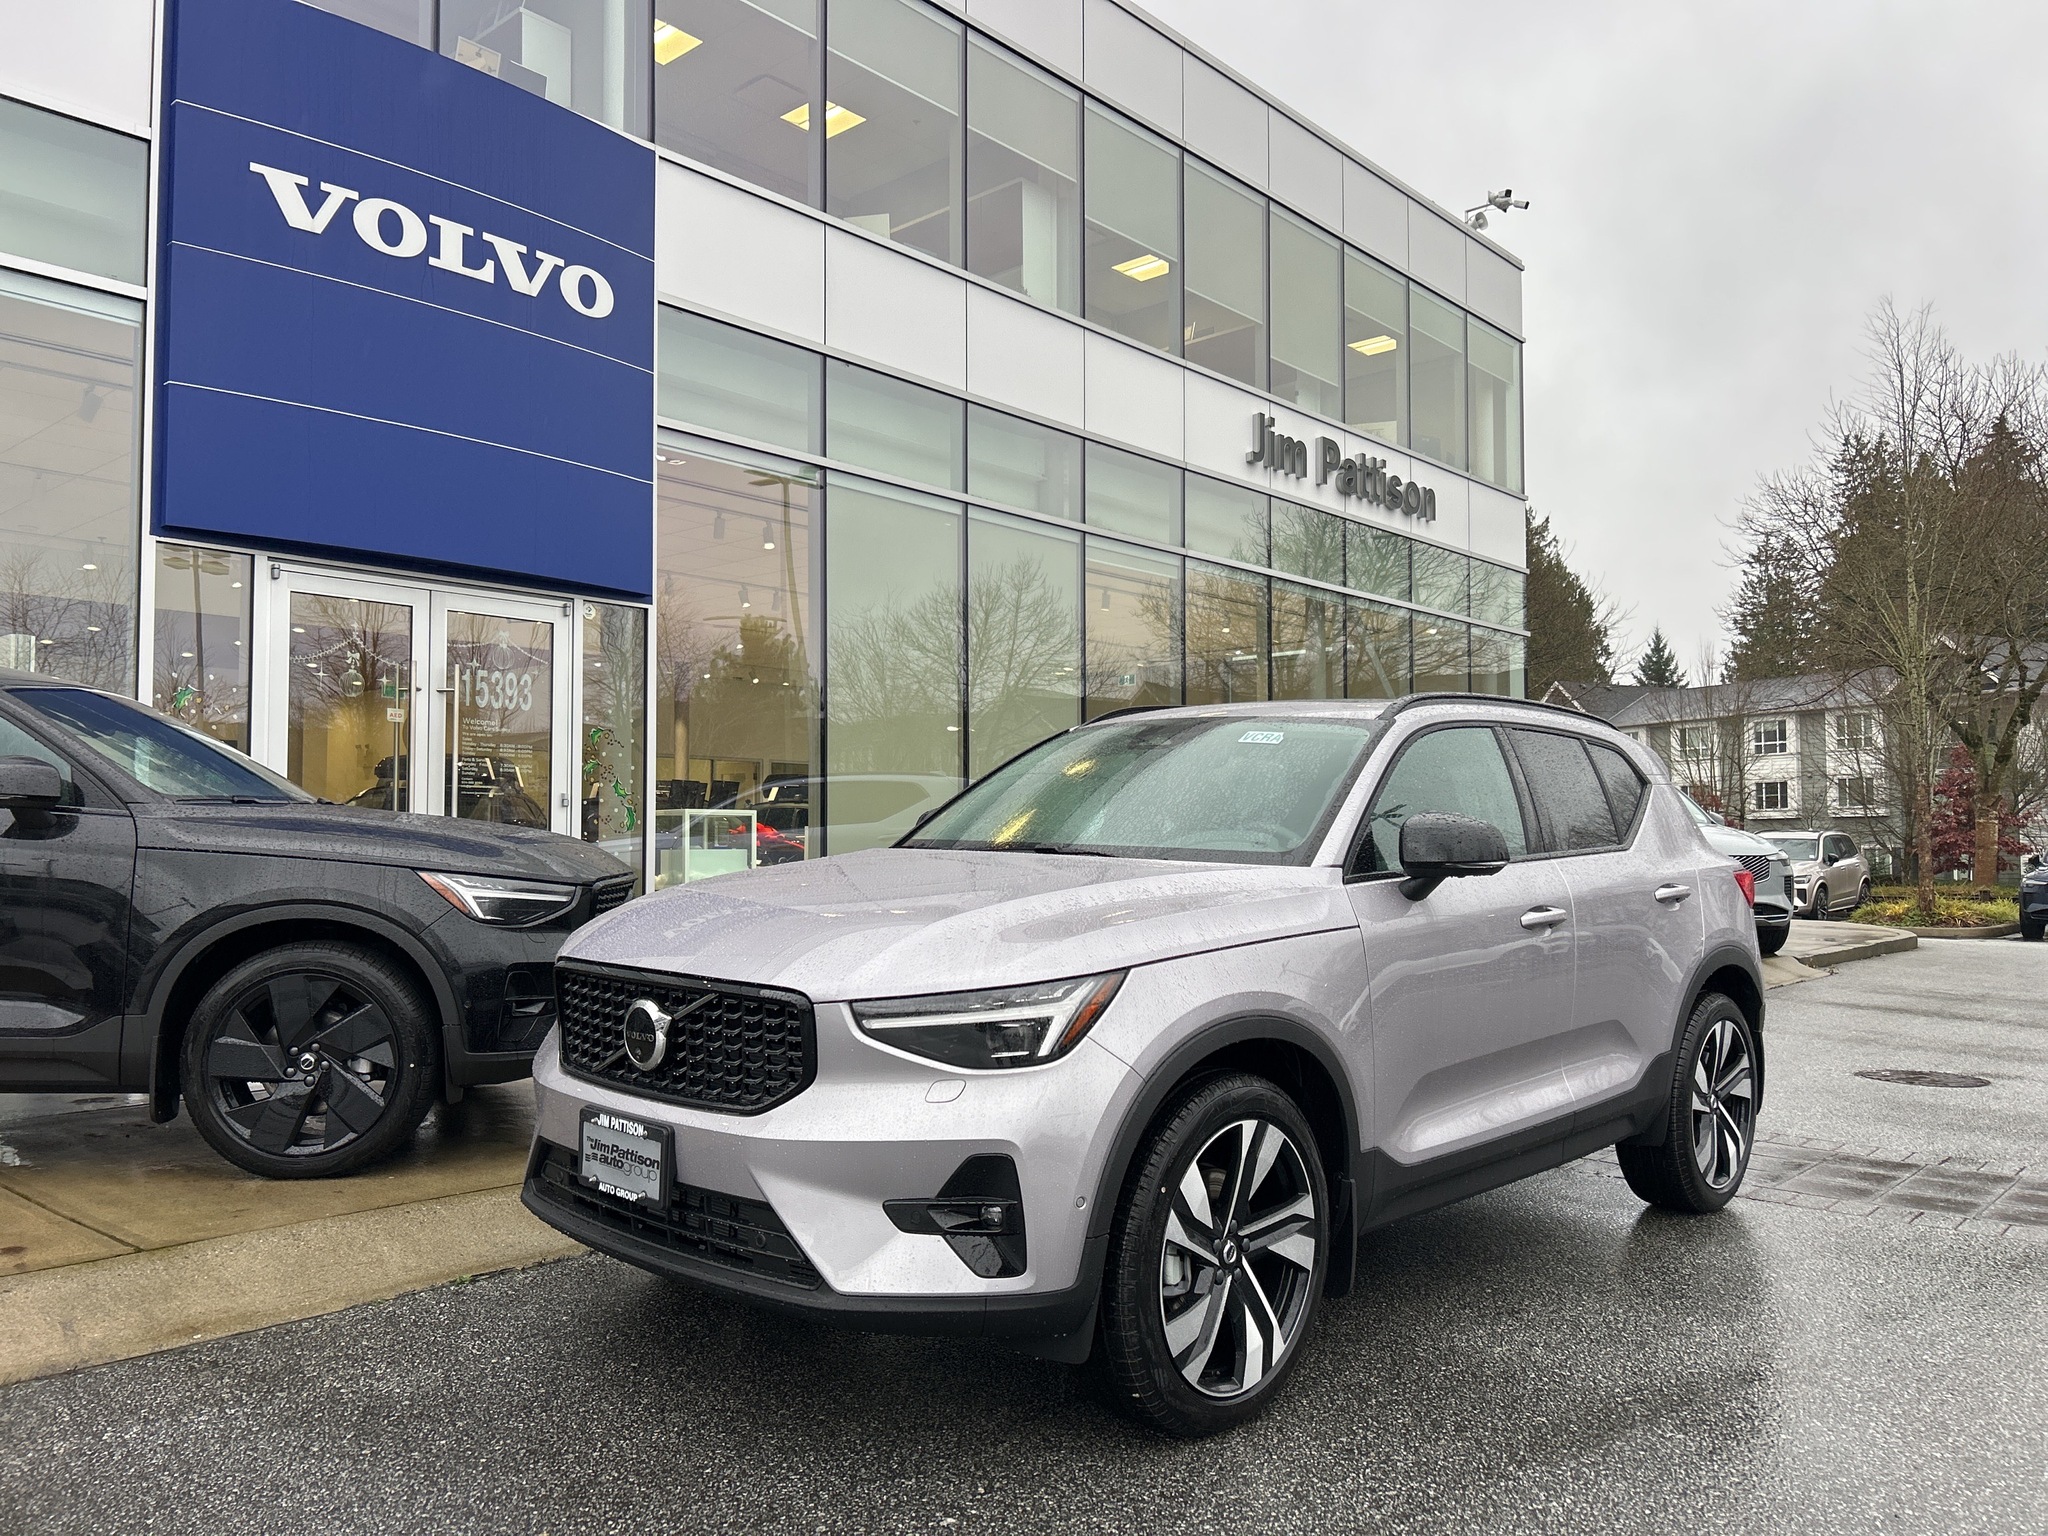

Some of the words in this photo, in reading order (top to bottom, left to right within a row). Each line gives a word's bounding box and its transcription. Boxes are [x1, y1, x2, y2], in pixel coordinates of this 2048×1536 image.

[249, 161, 614, 319] VOLVO
[1245, 412, 1307, 480] Jim
[1315, 436, 1436, 523] Pattison
[461, 668, 533, 711] 15393
[462, 717, 498, 726] Welcome!
[1242, 732, 1282, 743] VCRA
[627, 1031, 655, 1043] VOLVO
[597, 1113, 610, 1128] JIM
[610, 1116, 644, 1137] PATTISON
[598, 1182, 615, 1195] AUTO
[615, 1187, 638, 1202] GROUP
